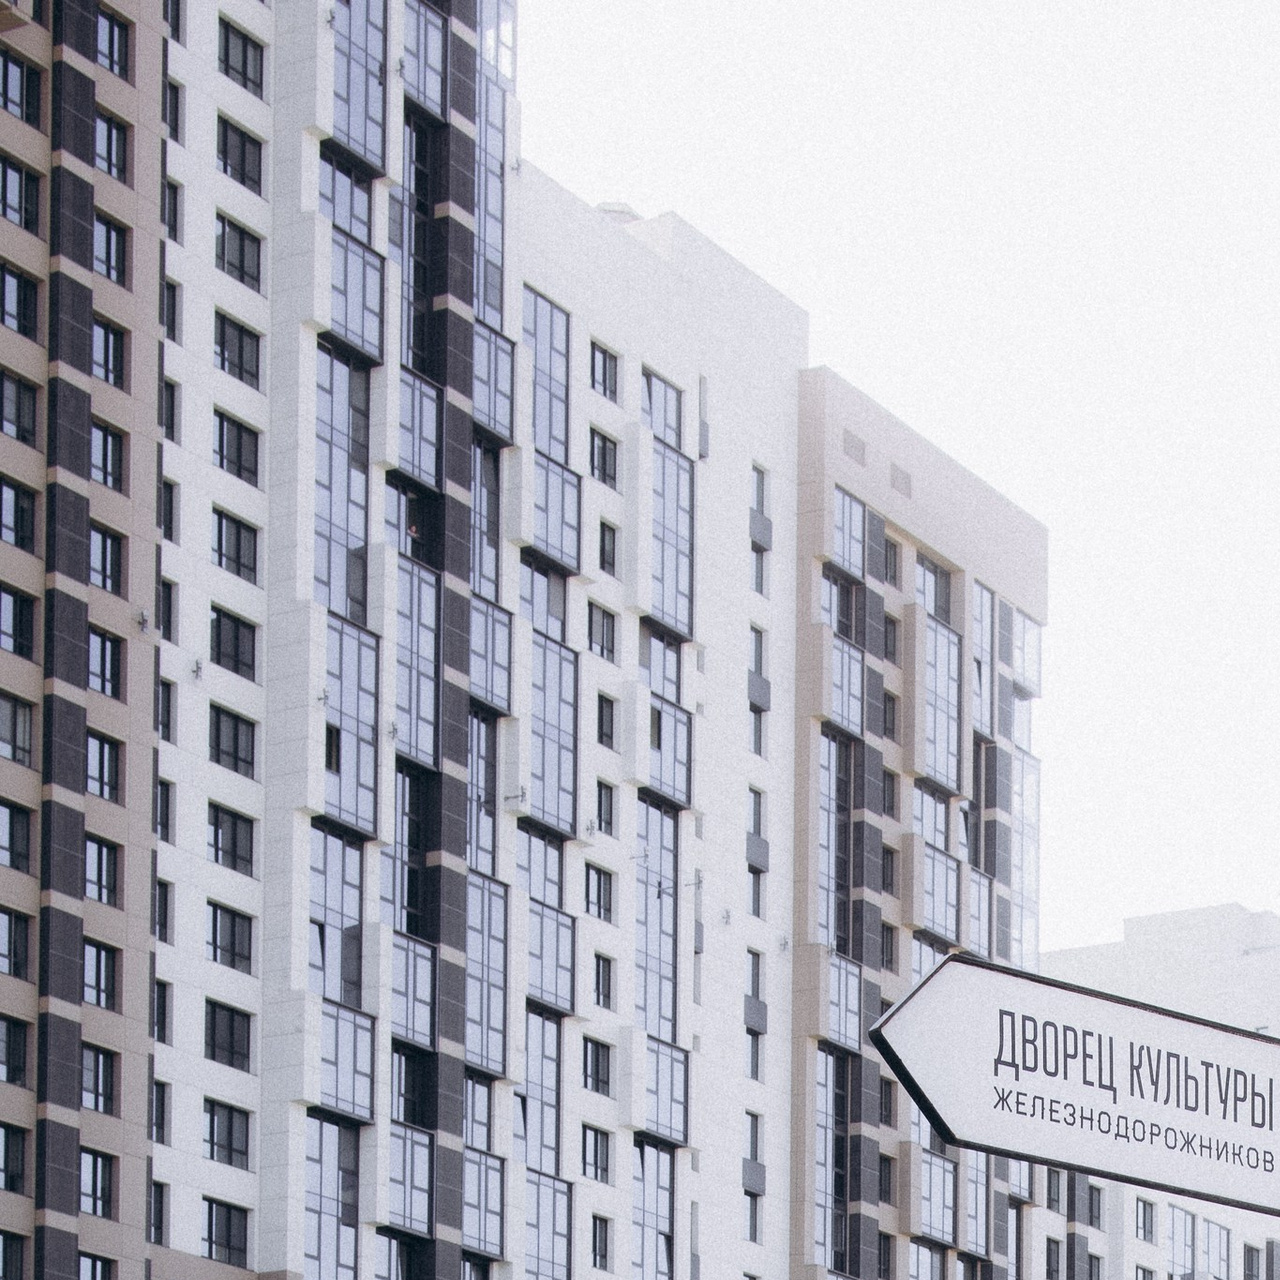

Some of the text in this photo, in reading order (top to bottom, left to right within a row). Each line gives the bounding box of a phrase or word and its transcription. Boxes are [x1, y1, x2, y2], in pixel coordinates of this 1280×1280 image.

[994, 1009, 1274, 1131] ДВОРЕЦ КУЛЬТУРЫ
[993, 1085, 1275, 1173] ЖЕЛЕЗНОДОРОЖНИКОВ
